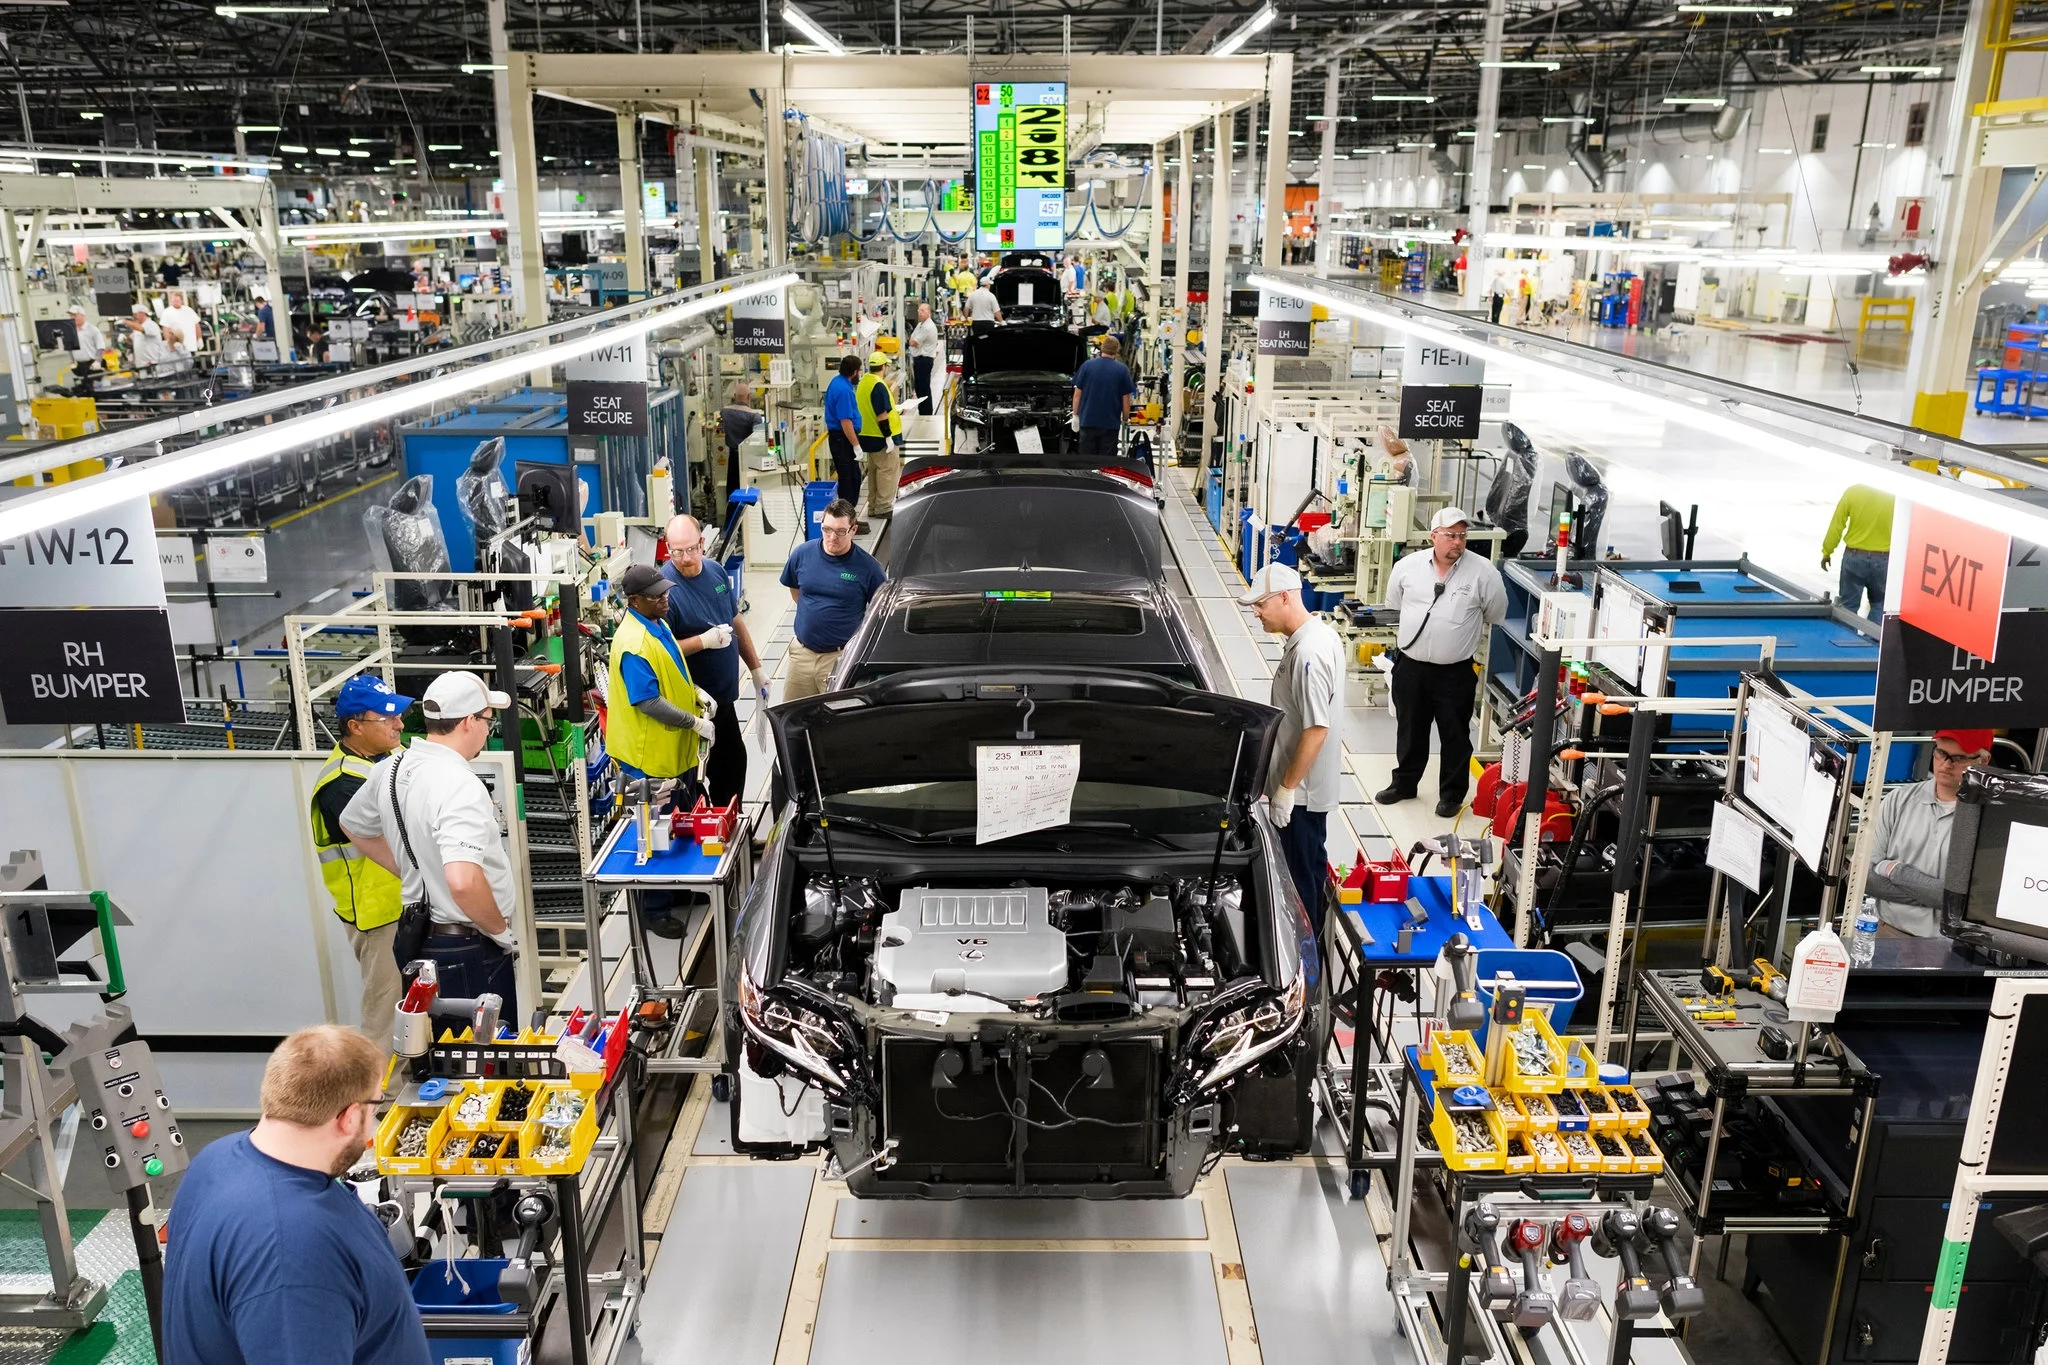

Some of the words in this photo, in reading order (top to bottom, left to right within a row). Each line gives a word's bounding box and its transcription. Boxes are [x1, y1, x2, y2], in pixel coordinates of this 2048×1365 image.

[976, 89, 990, 100] C2
[1000, 85, 1012, 96] 50
[1042, 203, 1060, 214] 457
[1006, 229, 1012, 241] 9
[1269, 296, 1304, 309] F1E-10
[753, 328, 765, 336] RH
[578, 346, 632, 362] 1W-11
[593, 396, 622, 409] SEAT
[1426, 400, 1456, 412] SEAT
[583, 412, 632, 425] SECURE
[1414, 414, 1464, 428] SECURE
[1921, 543, 1983, 612] EXIT
[62, 642, 105, 667] RH
[1952, 646, 1986, 671] LH
[31, 673, 150, 698] BUMPER
[1909, 677, 2023, 704] BUMPER
[995, 752, 1012, 760] 235
[18, 910, 33, 935] 1
[1620, 1213, 1637, 1222] BSM
